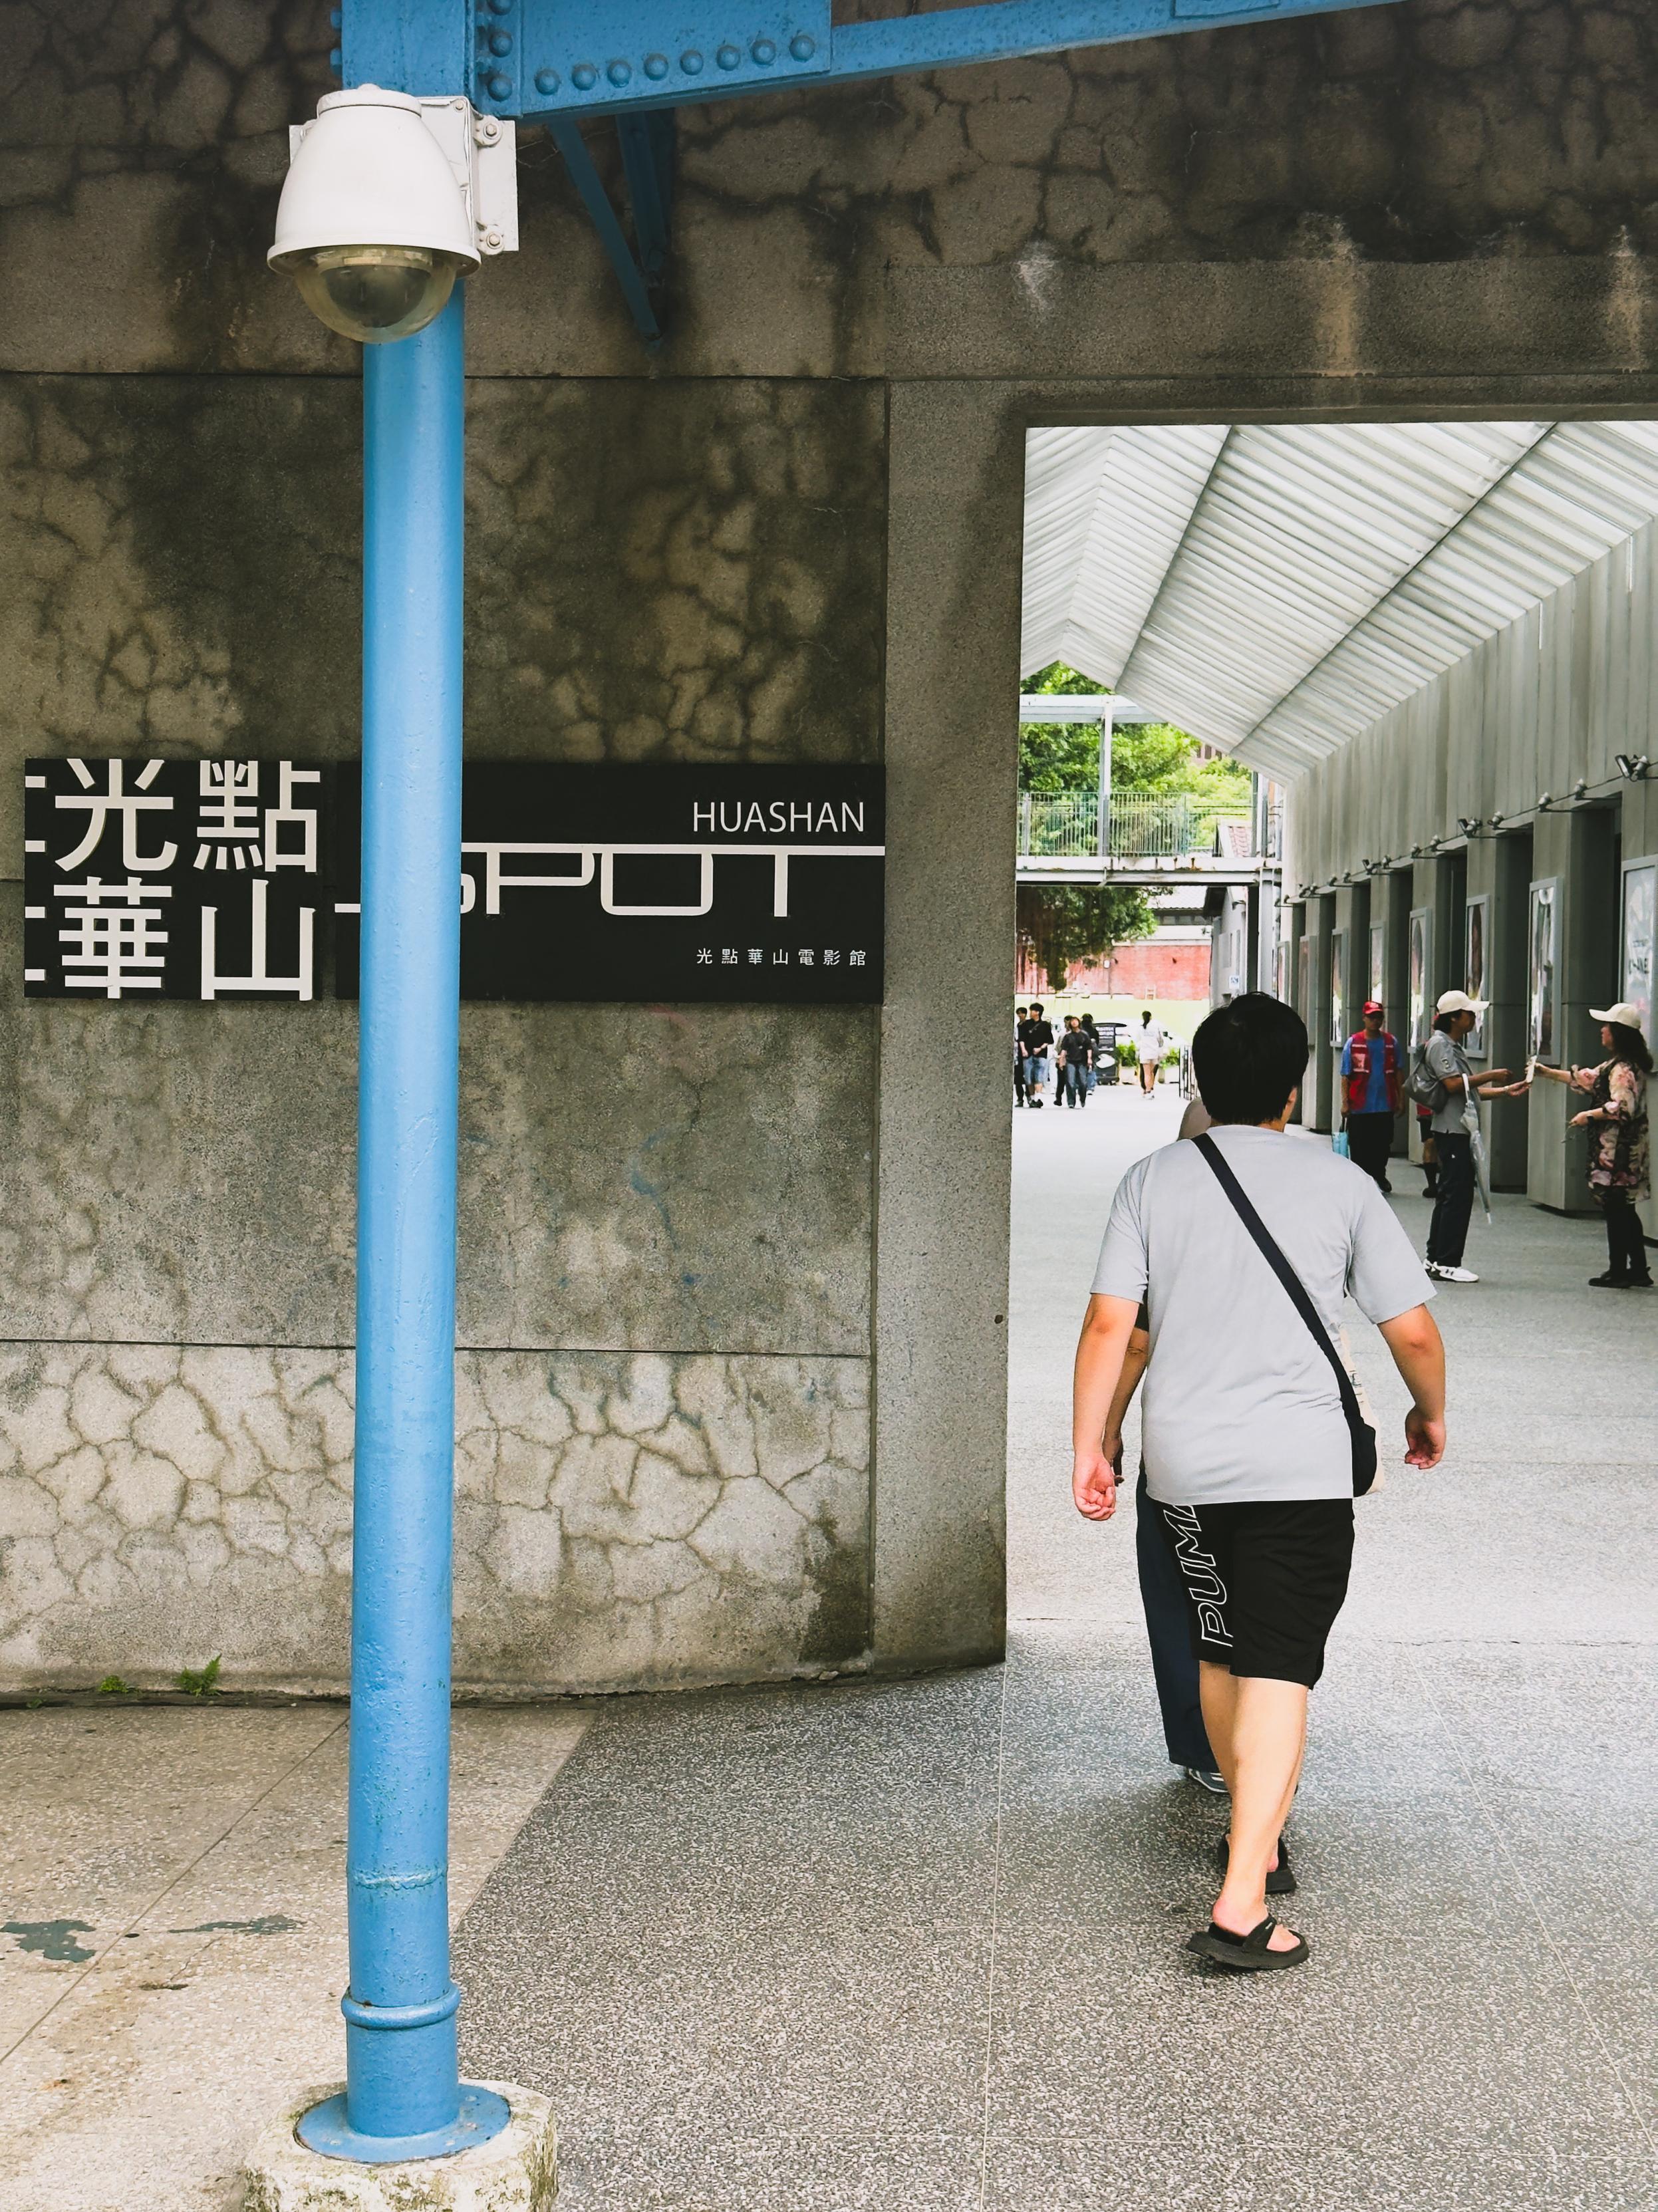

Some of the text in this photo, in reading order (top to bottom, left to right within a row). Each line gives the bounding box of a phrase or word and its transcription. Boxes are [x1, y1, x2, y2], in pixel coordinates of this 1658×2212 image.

[55, 760, 321, 873] 光點
[693, 801, 864, 833] HUASHAN
[54, 877, 316, 1001] 華山
[696, 948, 866, 966] 光點華山電影館
[1163, 1505, 1234, 1647] PUM
